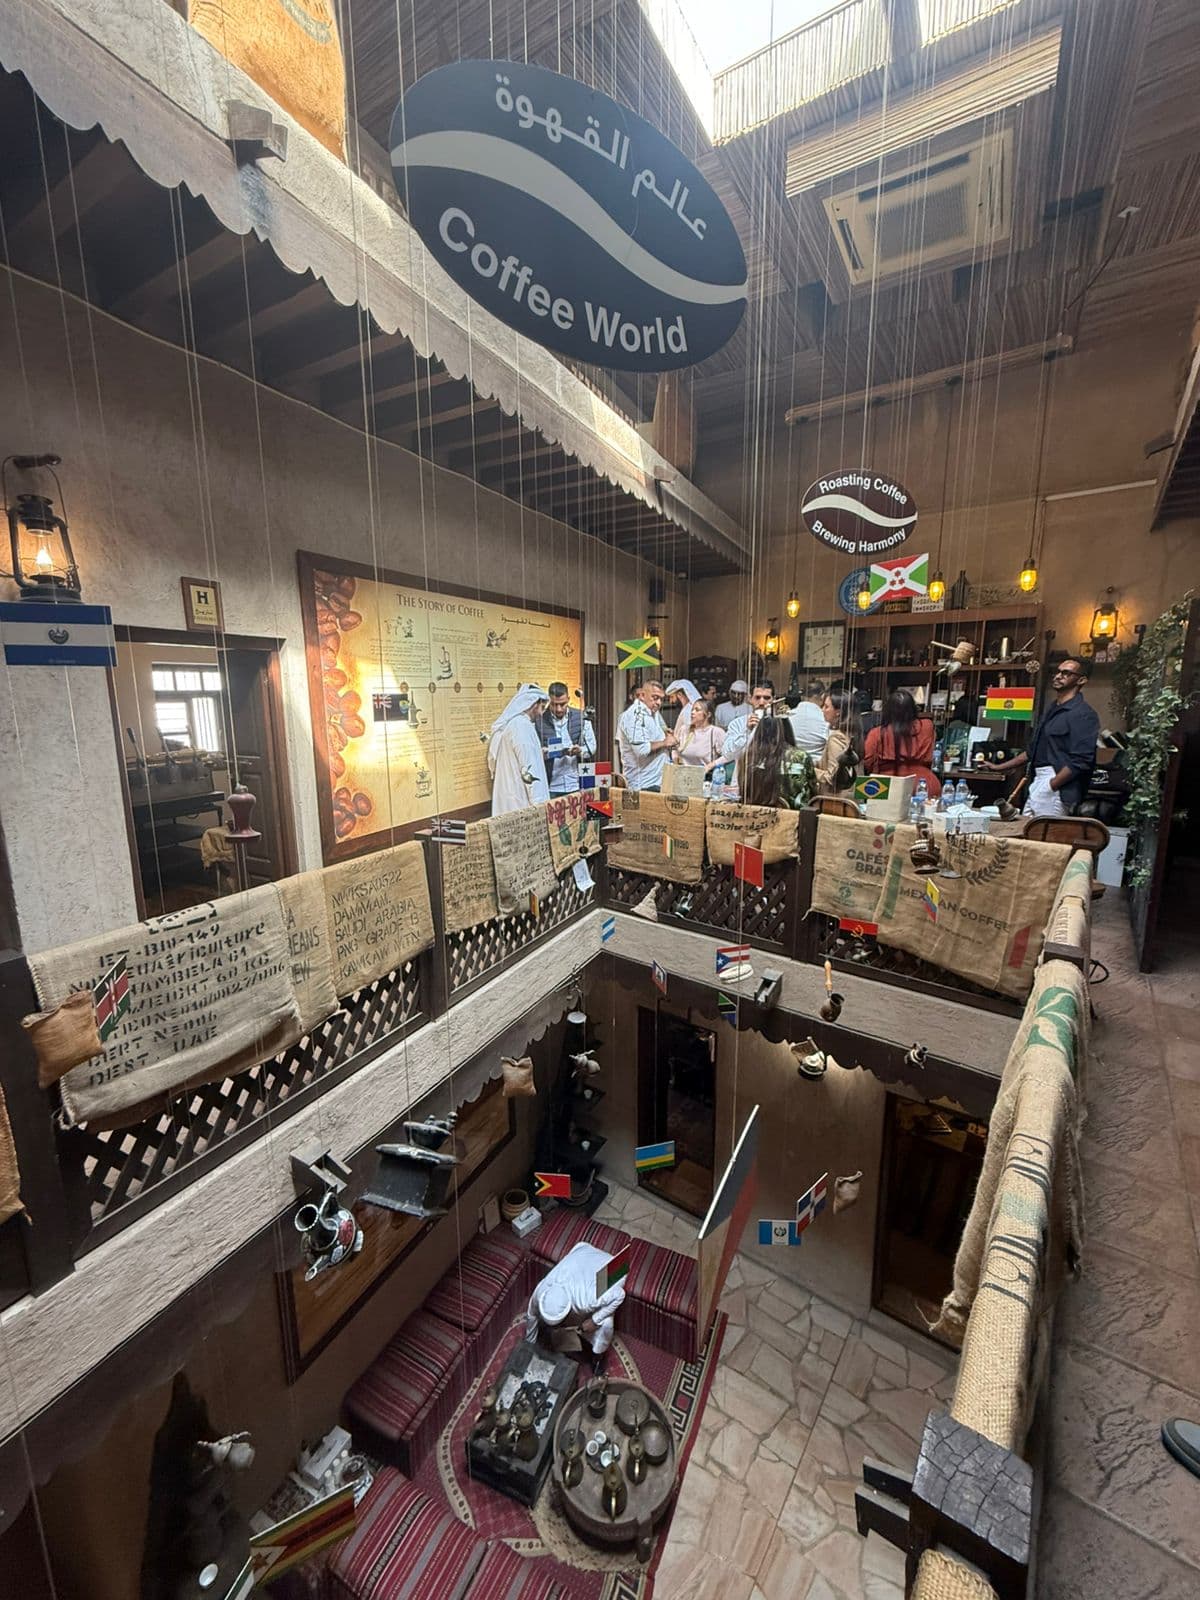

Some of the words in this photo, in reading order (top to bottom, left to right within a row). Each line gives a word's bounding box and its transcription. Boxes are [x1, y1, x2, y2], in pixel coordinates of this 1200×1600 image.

[495, 74, 630, 169] القهوة
[632, 168, 707, 240] عالم
[439, 207, 575, 330] Coffee
[584, 301, 688, 354] World
[819, 473, 872, 494] Roasting
[873, 478, 908, 505] Coffee
[811, 520, 857, 553] Brewing
[859, 528, 906, 552] Harmony
[196, 591, 209, 605] H
[396, 593, 416, 608] THE
[418, 597, 445, 612] STORY
[446, 603, 456, 614] OF
[458, 604, 484, 618] COFFEE
[855, 862, 887, 877] BRA
[899, 887, 958, 913] MEXAN
[959, 907, 1010, 932] COFFEE
[335, 917, 367, 942] SAUDI
